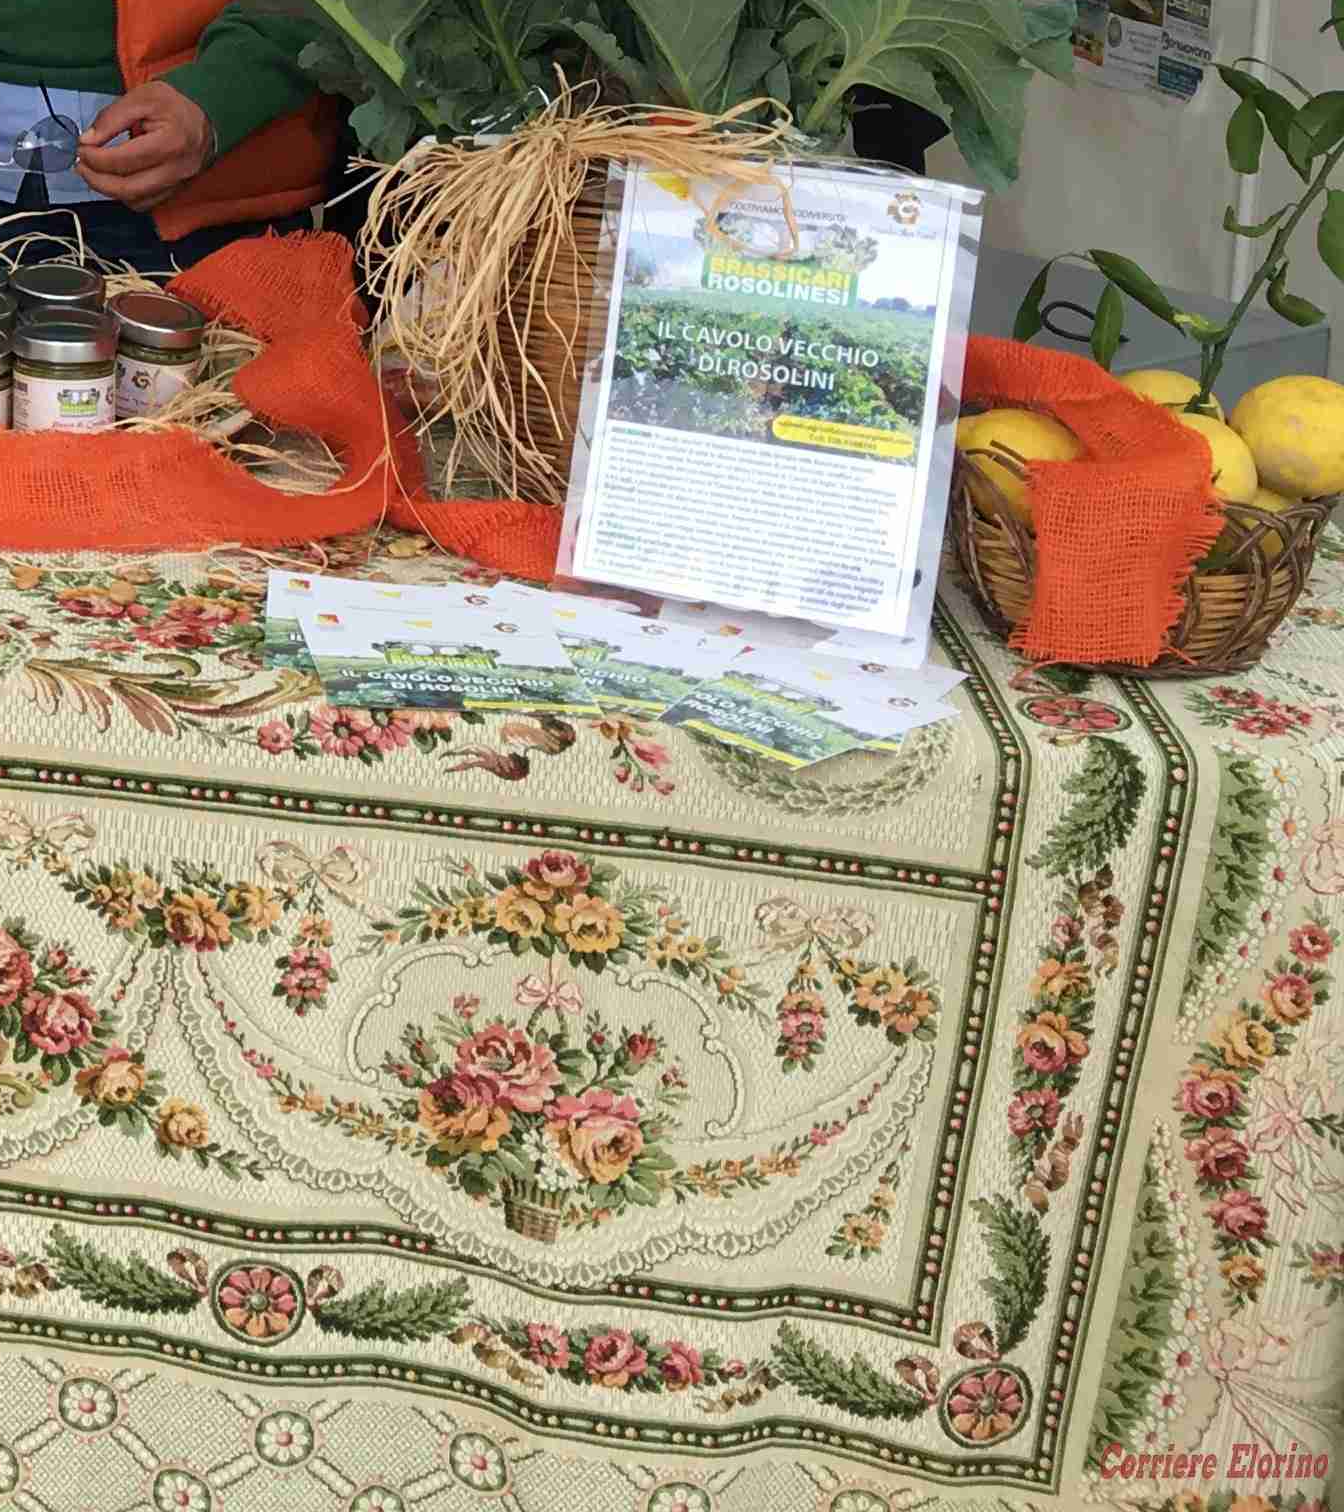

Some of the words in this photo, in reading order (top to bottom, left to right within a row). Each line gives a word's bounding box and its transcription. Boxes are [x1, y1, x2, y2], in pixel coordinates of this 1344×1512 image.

[709, 256, 851, 289] BRASSICARI
[707, 273, 850, 307] ROSOLINESI
[657, 320, 678, 341] IL
[682, 322, 773, 354] CAVOLO
[777, 336, 880, 369] VECCHIO
[697, 353, 719, 375] DI
[726, 358, 837, 392] ROSOLINI
[340, 669, 360, 680] IL
[367, 670, 452, 684] CAVOLO
[459, 675, 555, 689] VECCHIO
[420, 682, 521, 695] ROSOLINI
[580, 667, 648, 685] CCHIO
[739, 702, 825, 743] VECCHIO
